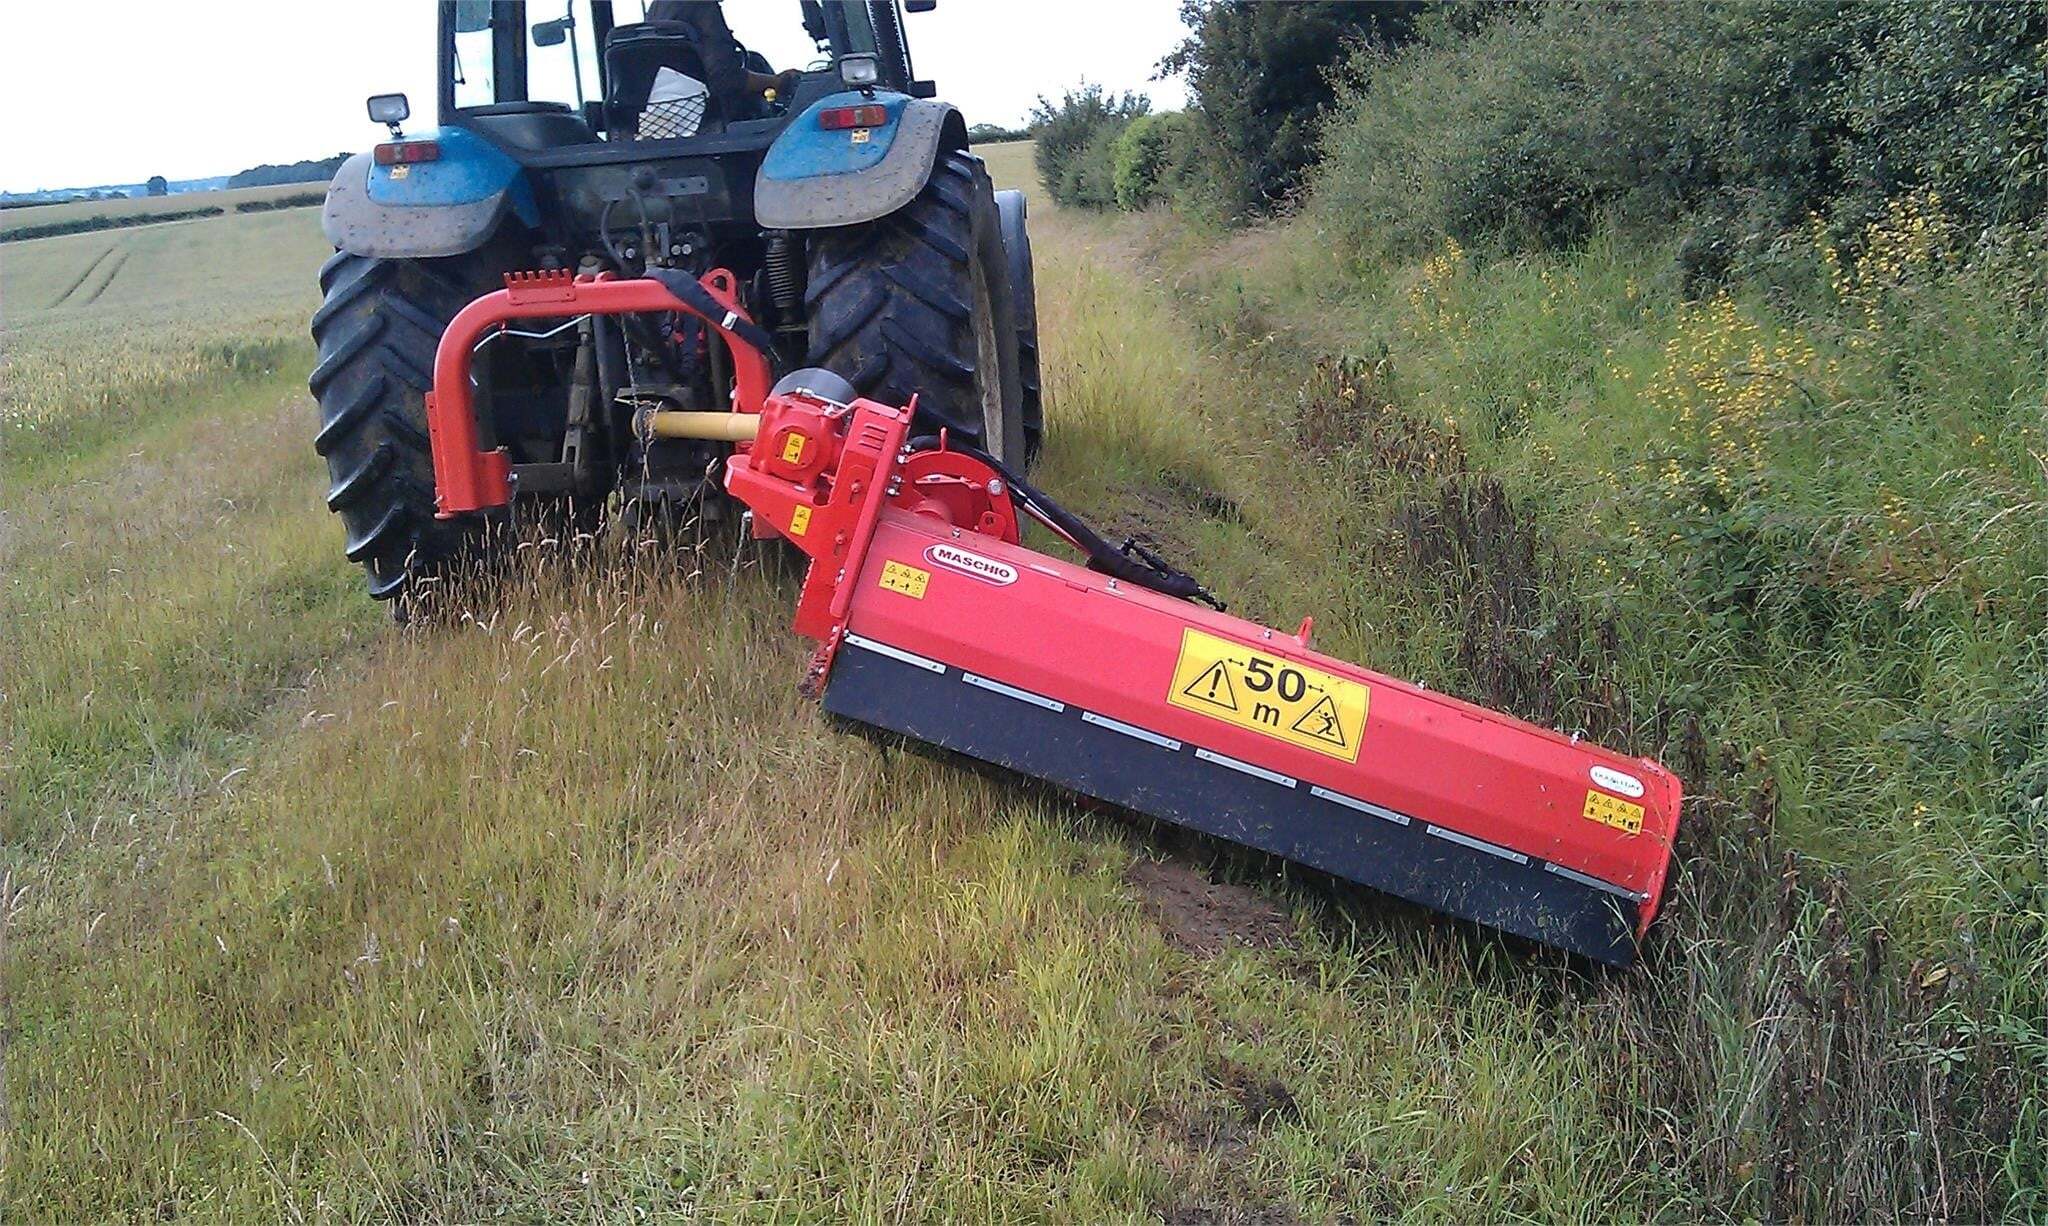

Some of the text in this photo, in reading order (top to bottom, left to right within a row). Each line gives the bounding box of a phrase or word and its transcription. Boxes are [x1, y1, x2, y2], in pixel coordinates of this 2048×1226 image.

[938, 549, 1010, 578] MASCHIO
[1244, 657, 1306, 702] 50
[1253, 702, 1280, 727] m
